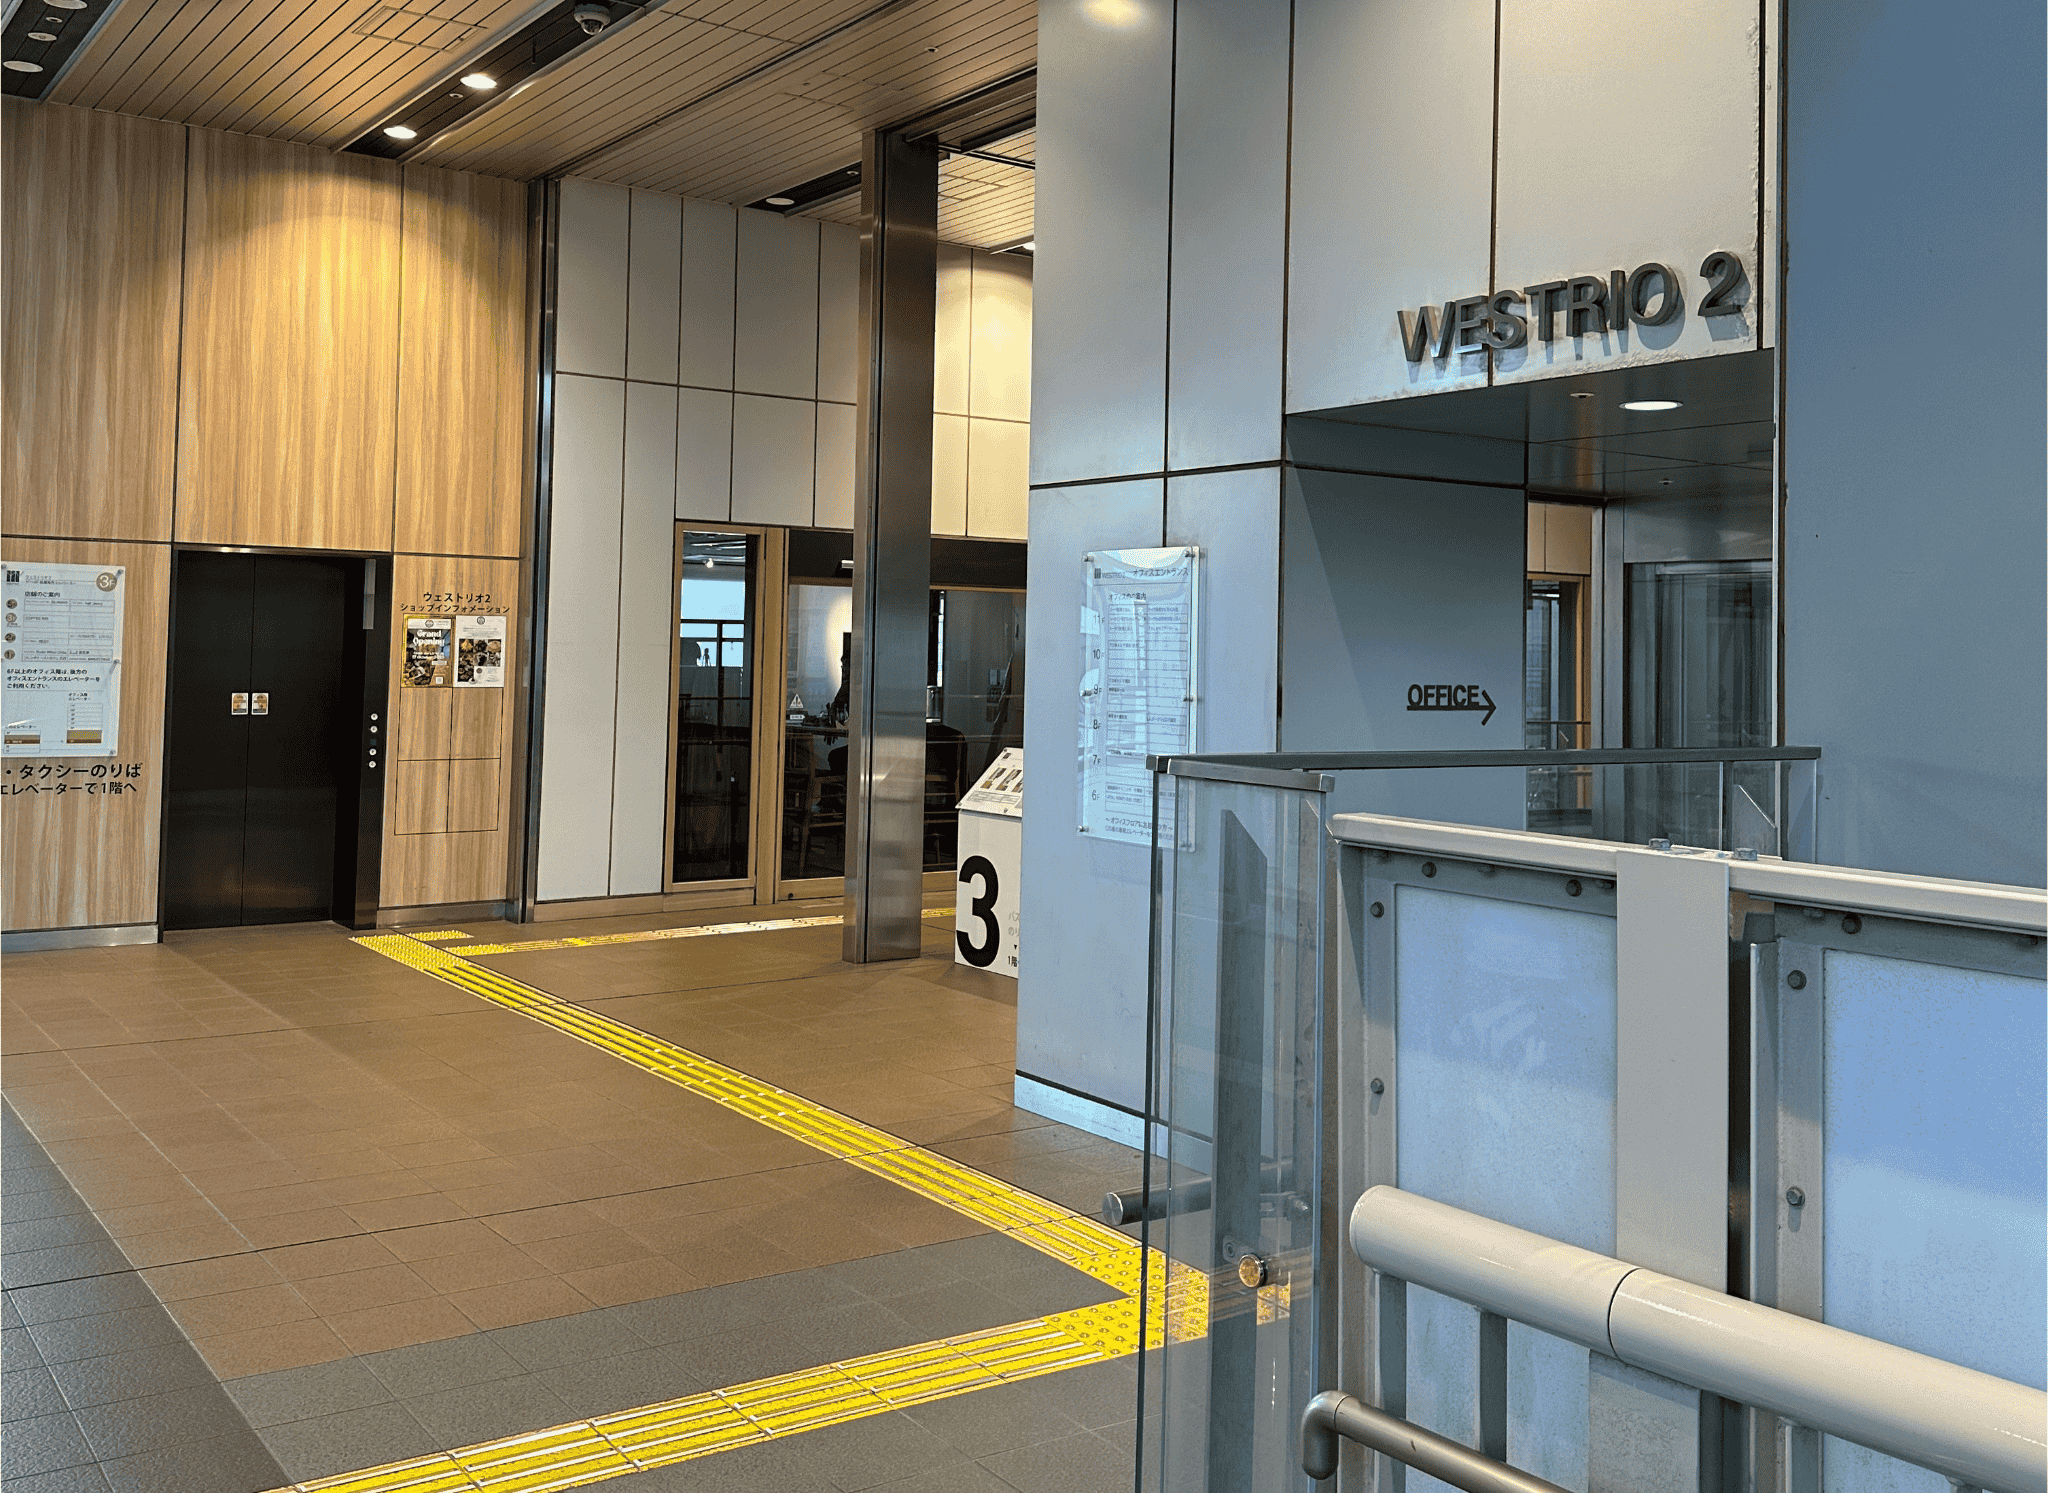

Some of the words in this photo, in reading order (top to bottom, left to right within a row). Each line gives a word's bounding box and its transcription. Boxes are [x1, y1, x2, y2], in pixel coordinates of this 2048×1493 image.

[1397, 262, 1680, 363] WESTRIO
[1697, 251, 1746, 318] 2
[99, 574, 116, 588] 3F
[423, 592, 491, 603] ウェストリオ2
[400, 603, 511, 614] ショップインフォメーション
[1408, 684, 1480, 707] OFFICE
[956, 855, 1001, 968] 3
